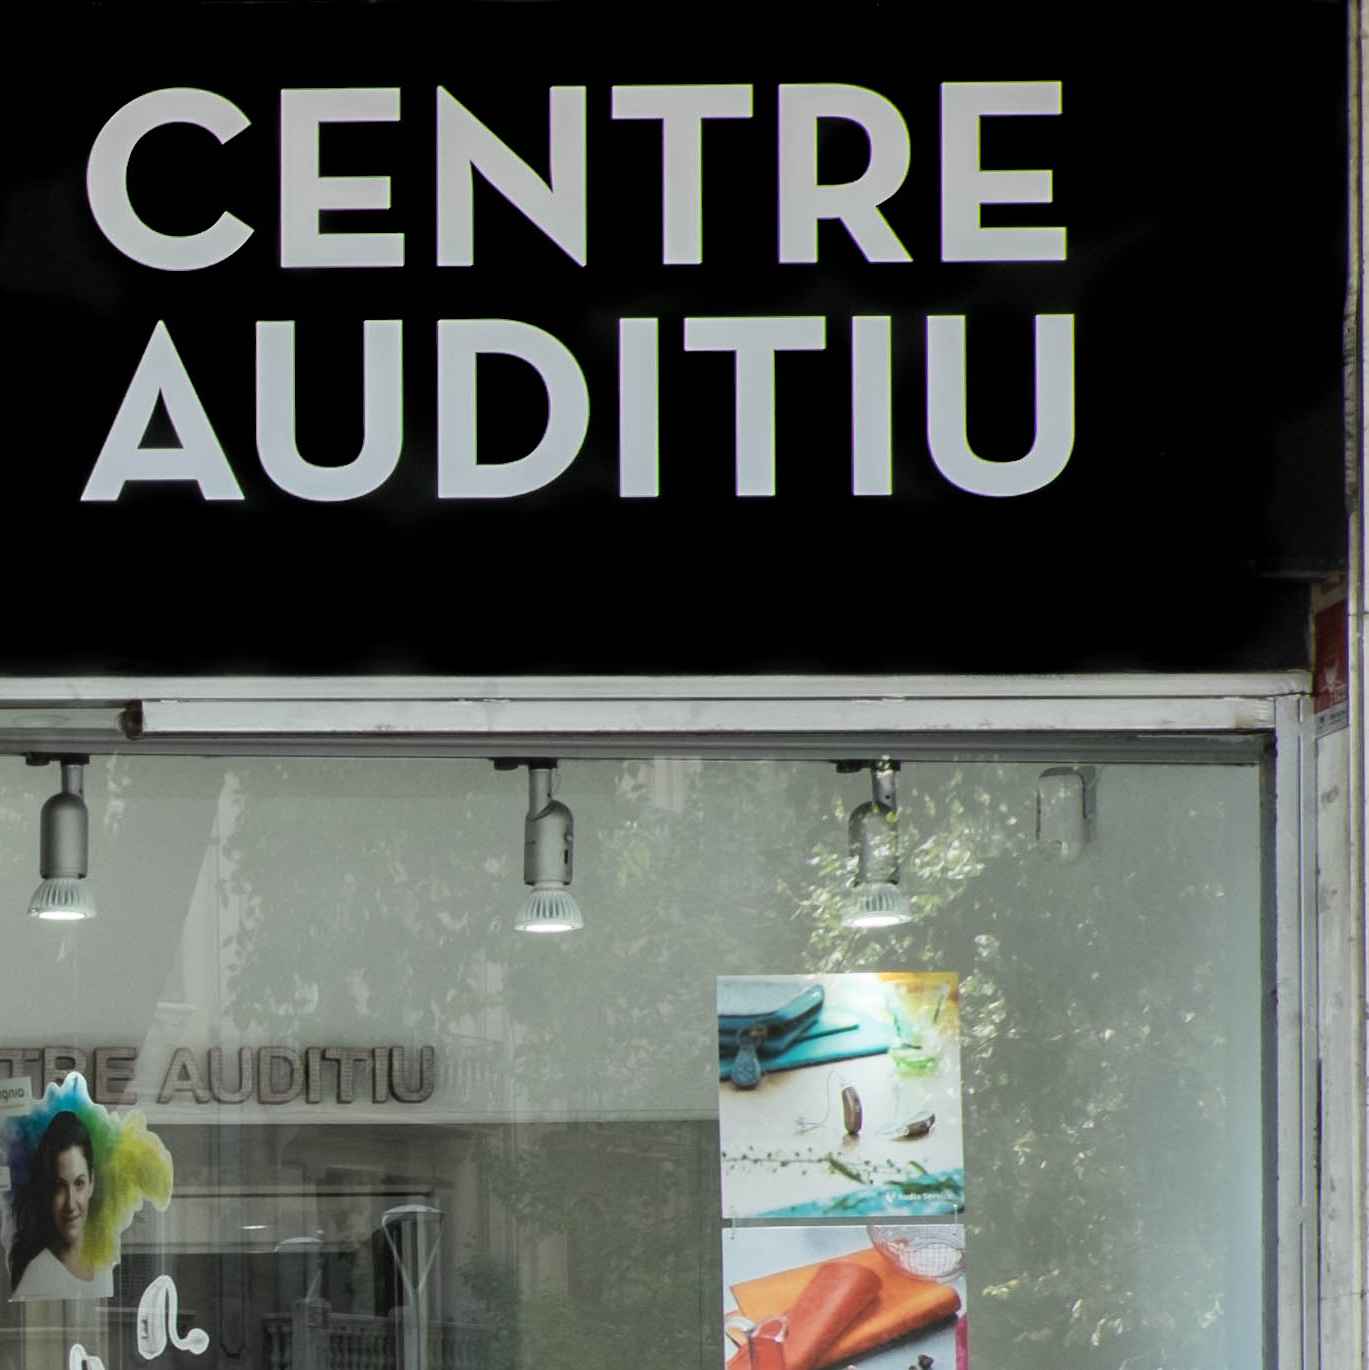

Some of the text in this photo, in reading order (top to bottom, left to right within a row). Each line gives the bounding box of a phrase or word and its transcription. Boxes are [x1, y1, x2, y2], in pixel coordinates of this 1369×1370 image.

[87, 81, 1066, 271] CENTRE
[81, 314, 1074, 501] AUDITIU
[156, 1046, 436, 1106] AUDITIU
